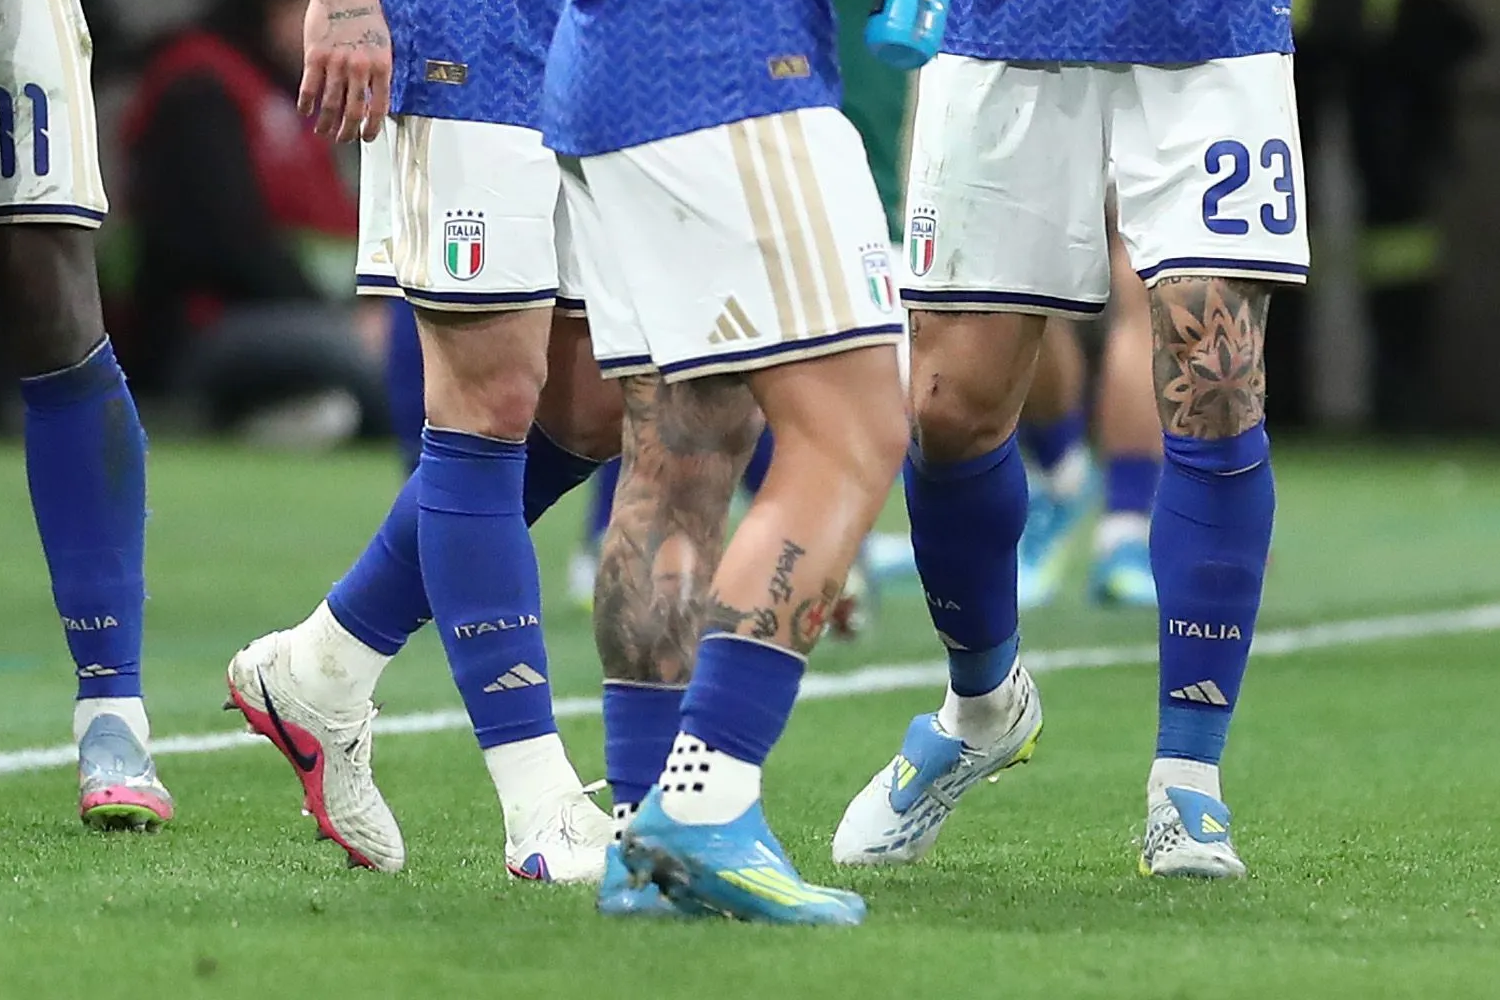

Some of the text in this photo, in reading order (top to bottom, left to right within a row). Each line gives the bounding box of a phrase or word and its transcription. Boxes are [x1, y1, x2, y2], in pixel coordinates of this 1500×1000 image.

[1202, 138, 1297, 235] 23
[448, 225, 481, 237] ITALIA
[927, 591, 961, 611] LIA
[62, 615, 118, 631] TALIA
[454, 613, 539, 640] ITALIA
[1168, 618, 1241, 641] ITALIA
